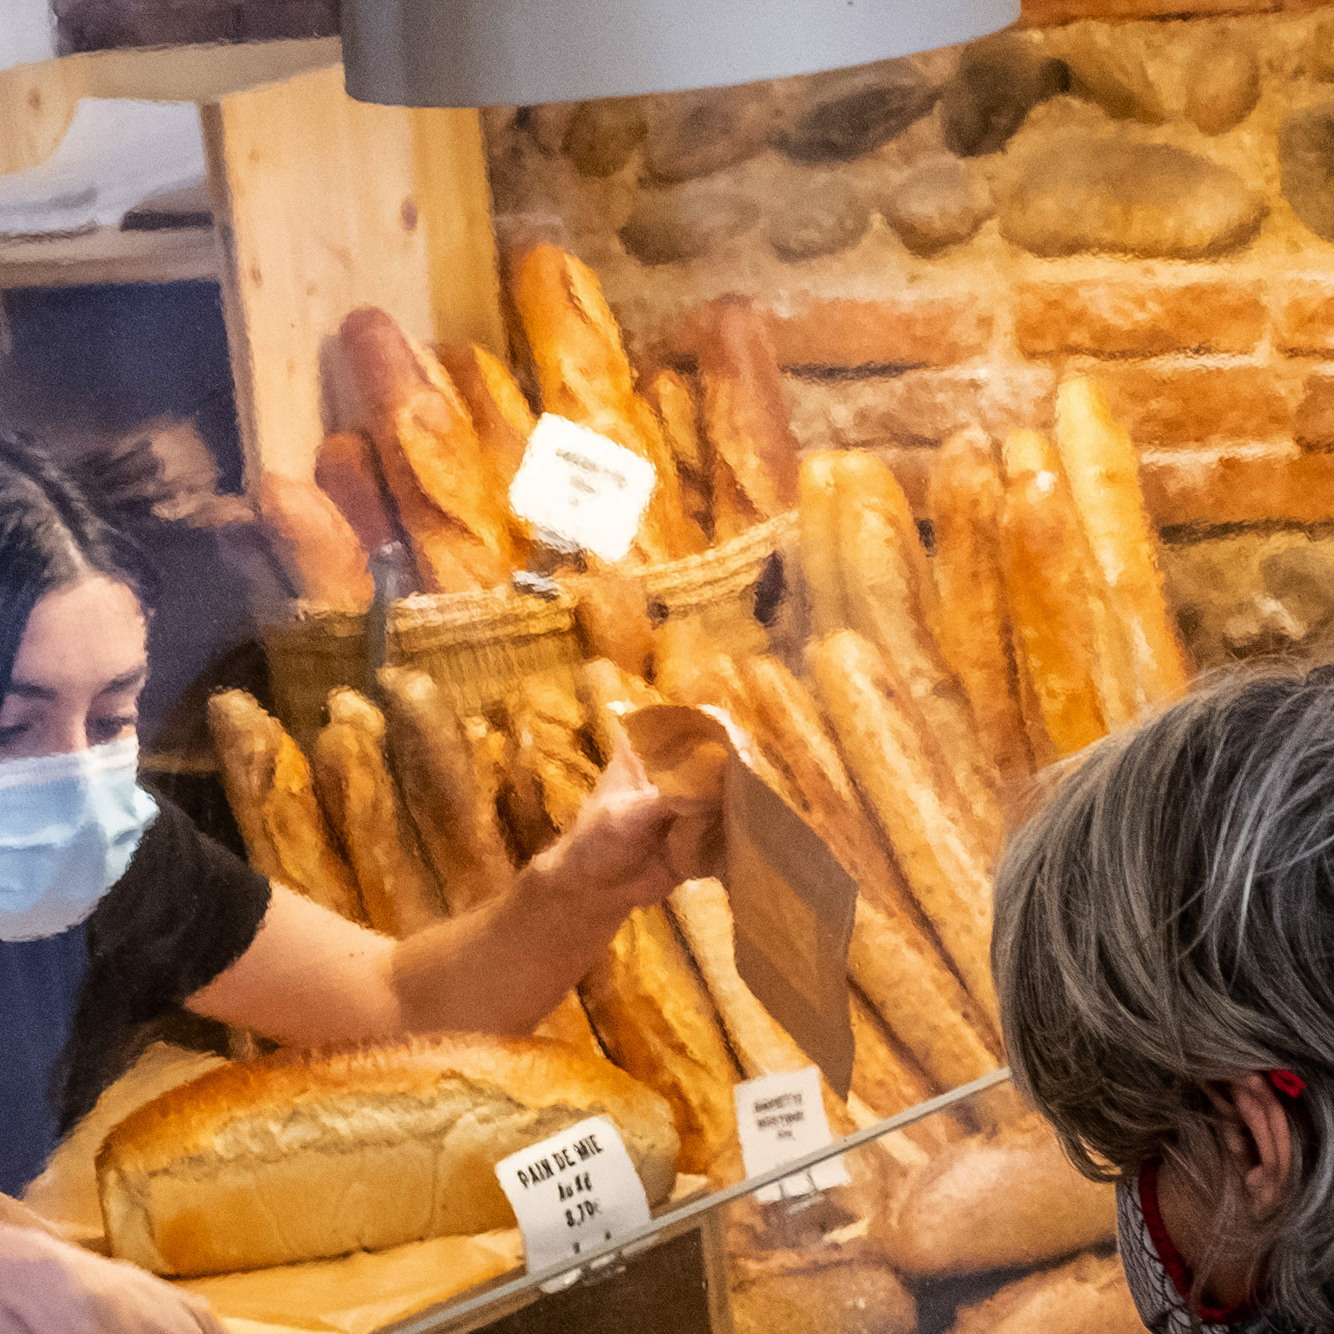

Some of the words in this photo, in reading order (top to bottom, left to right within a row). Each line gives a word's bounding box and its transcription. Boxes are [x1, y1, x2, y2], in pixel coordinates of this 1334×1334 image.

[517, 1158, 553, 1189] PAIN
[556, 1149, 578, 1171] DE
[574, 1134, 604, 1161] MIE
